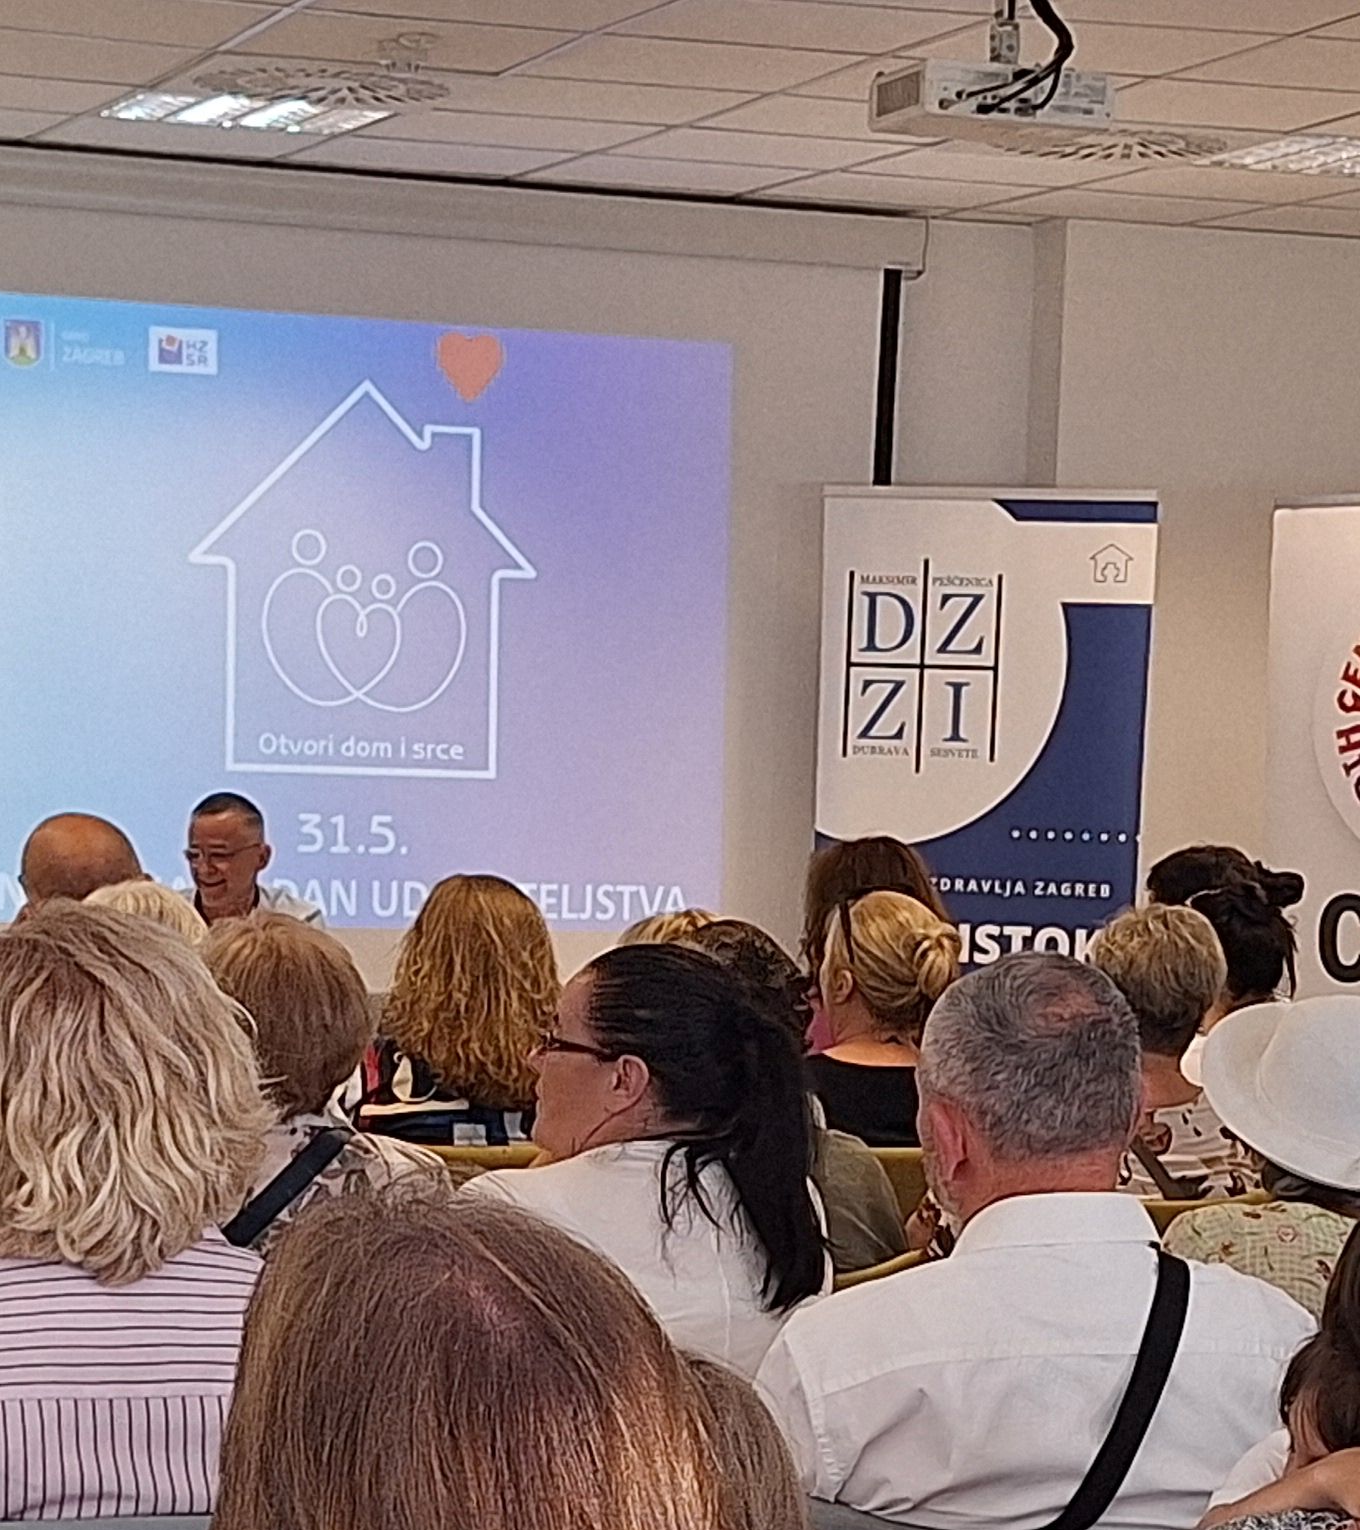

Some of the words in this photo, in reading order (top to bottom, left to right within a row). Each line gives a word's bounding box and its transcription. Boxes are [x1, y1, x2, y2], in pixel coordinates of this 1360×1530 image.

[860, 574, 918, 586] MAKSIMIR
[857, 590, 916, 653] D
[935, 592, 986, 656] Z
[856, 678, 907, 741] Z
[258, 731, 334, 757] Otvori
[341, 735, 392, 759] dom
[399, 736, 406, 758] i
[412, 742, 465, 761] srce
[852, 744, 910, 757] DUBRAVA
[296, 812, 409, 856] 31.5.
[1034, 880, 1111, 899] ZAGREB
[957, 922, 1105, 966] ISTOK
